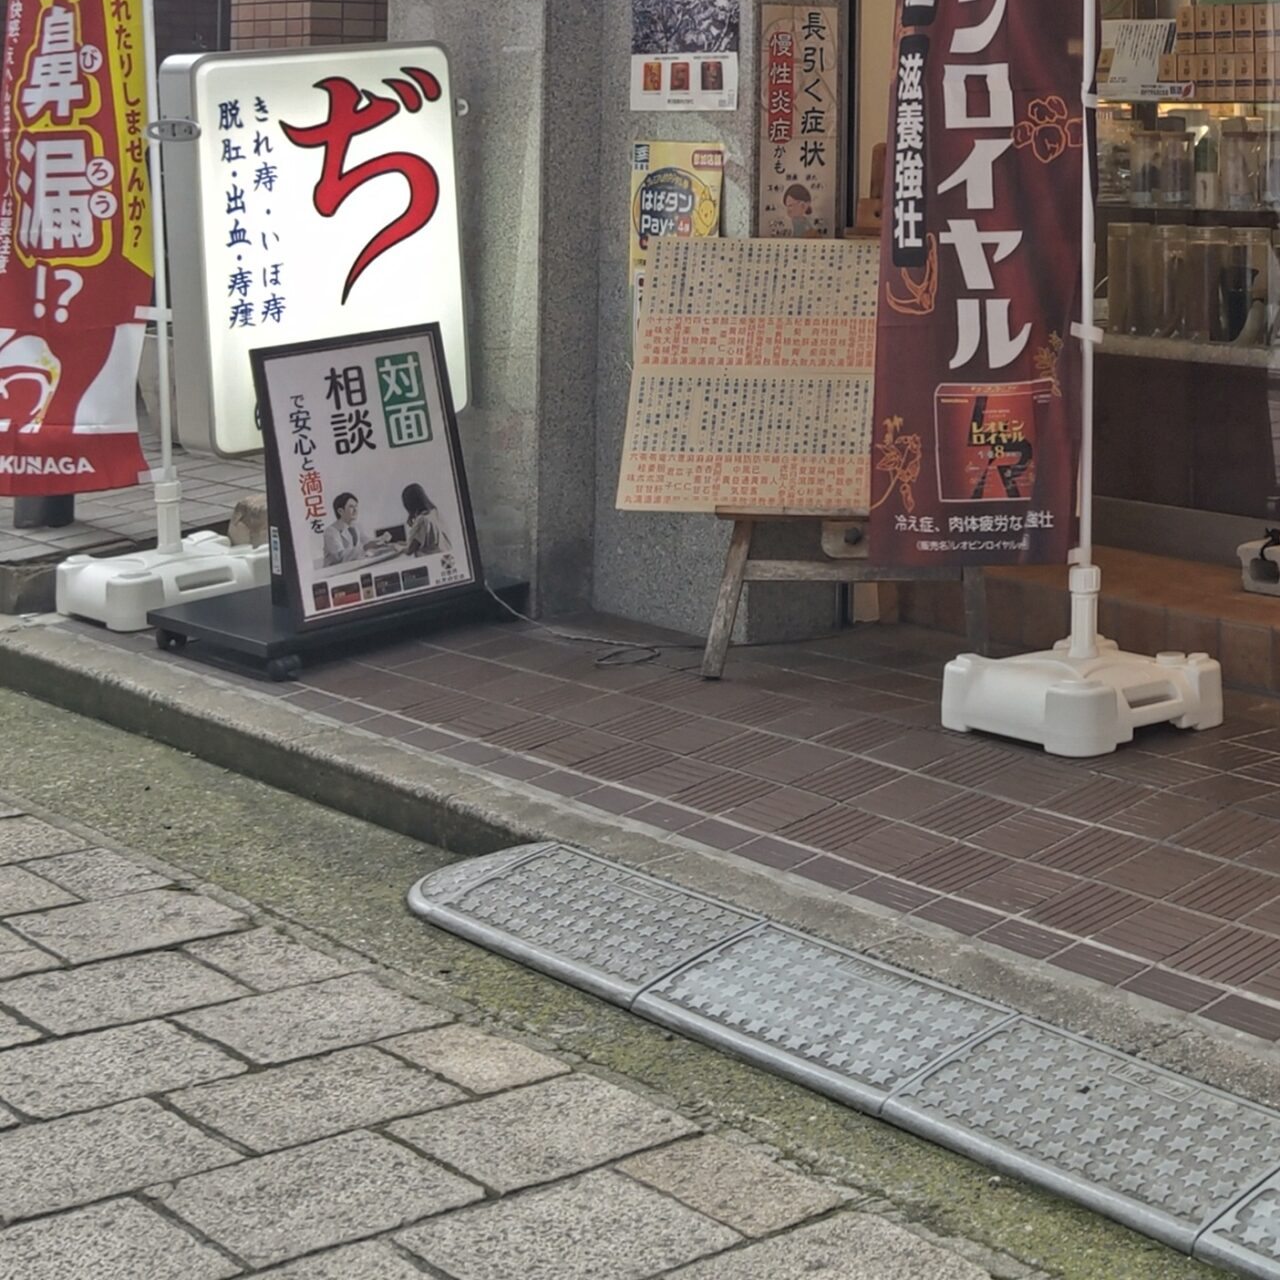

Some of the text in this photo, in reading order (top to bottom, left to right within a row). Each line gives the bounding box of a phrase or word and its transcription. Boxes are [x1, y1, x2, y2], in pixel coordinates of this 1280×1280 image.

[769, 33, 795, 174] 慢性炎症かも
[799, 10, 828, 168] 長引く症状
[278, 66, 442, 306] ぢ
[641, 189, 693, 213] はばタン
[288, 392, 328, 535] で安心と満足を
[325, 364, 376, 455] 相談
[376, 353, 429, 447] 対面
